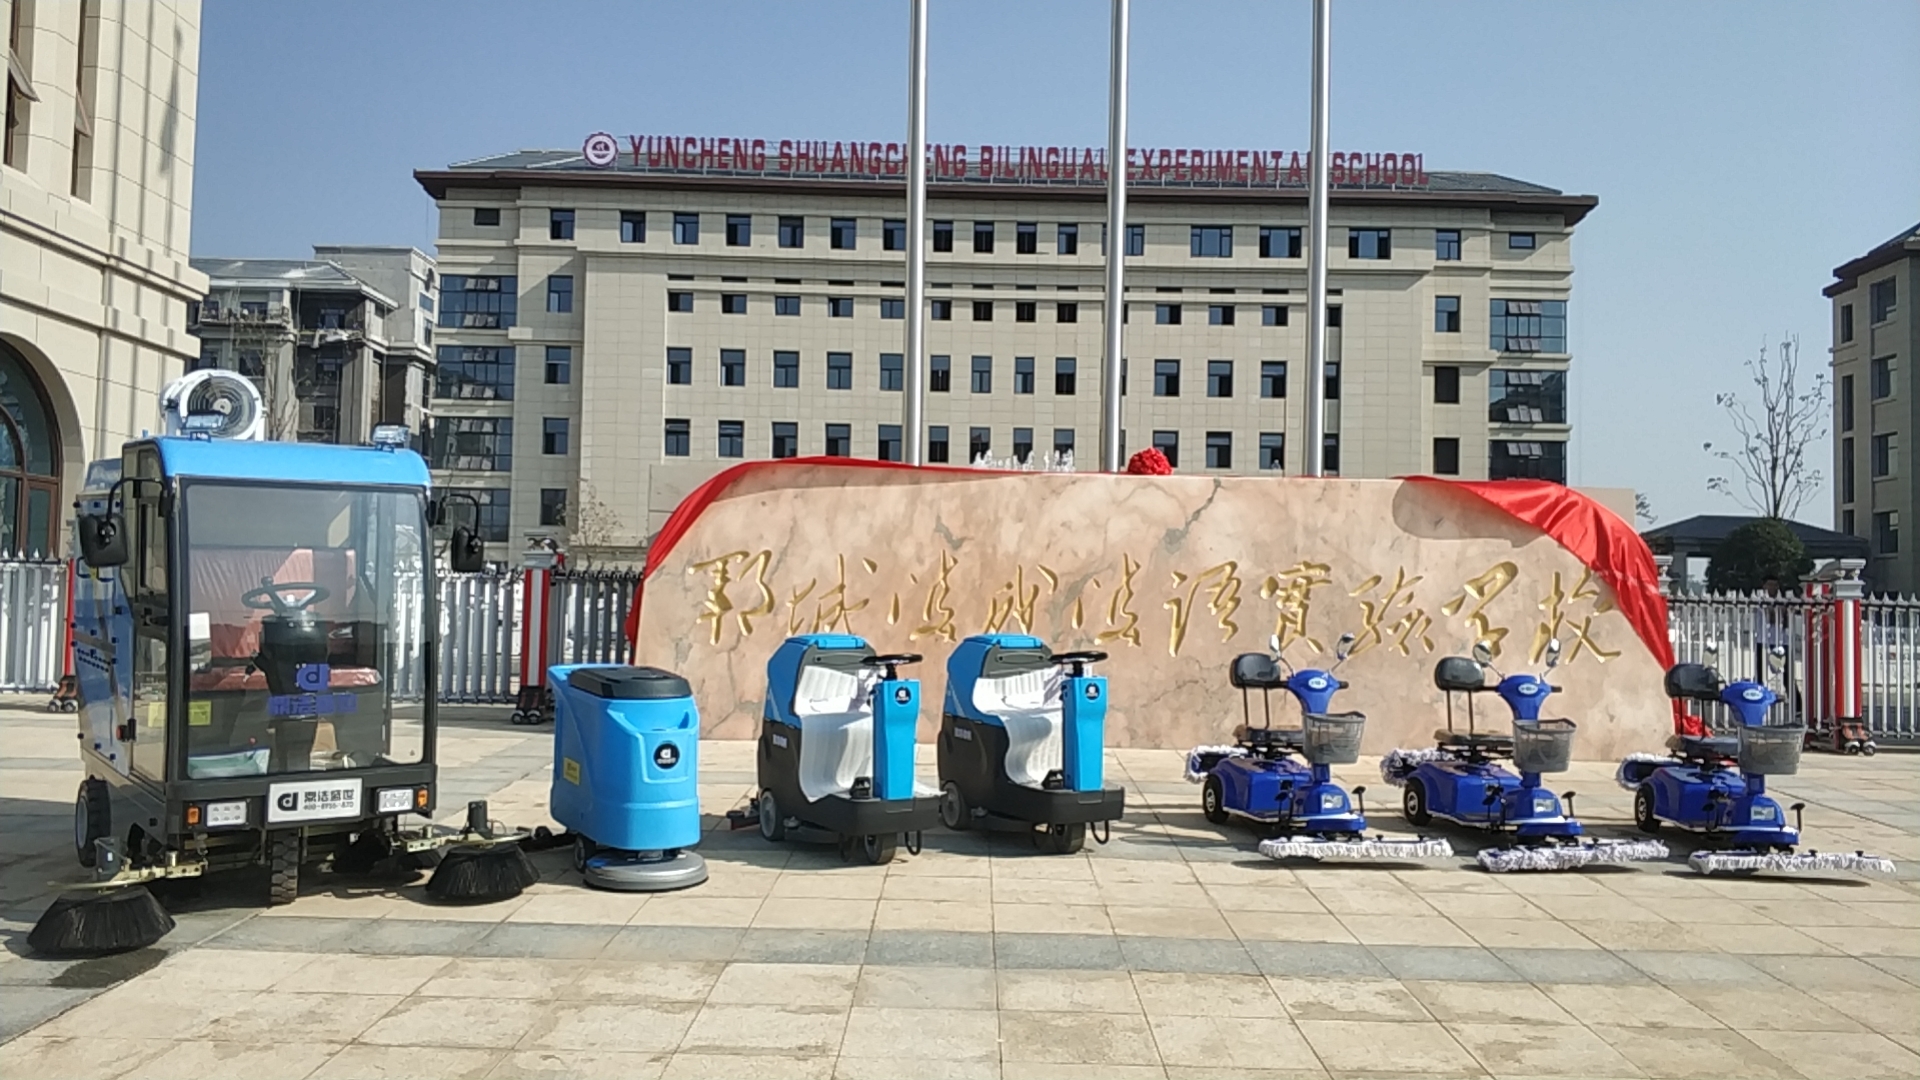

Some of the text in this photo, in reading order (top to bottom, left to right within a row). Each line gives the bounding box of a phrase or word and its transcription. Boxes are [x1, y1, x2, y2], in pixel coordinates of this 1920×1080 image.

[629, 134, 766, 171] YUNCHENG
[980, 145, 1109, 181] BILINGUAL
[1332, 151, 1429, 185] SCHOOL
